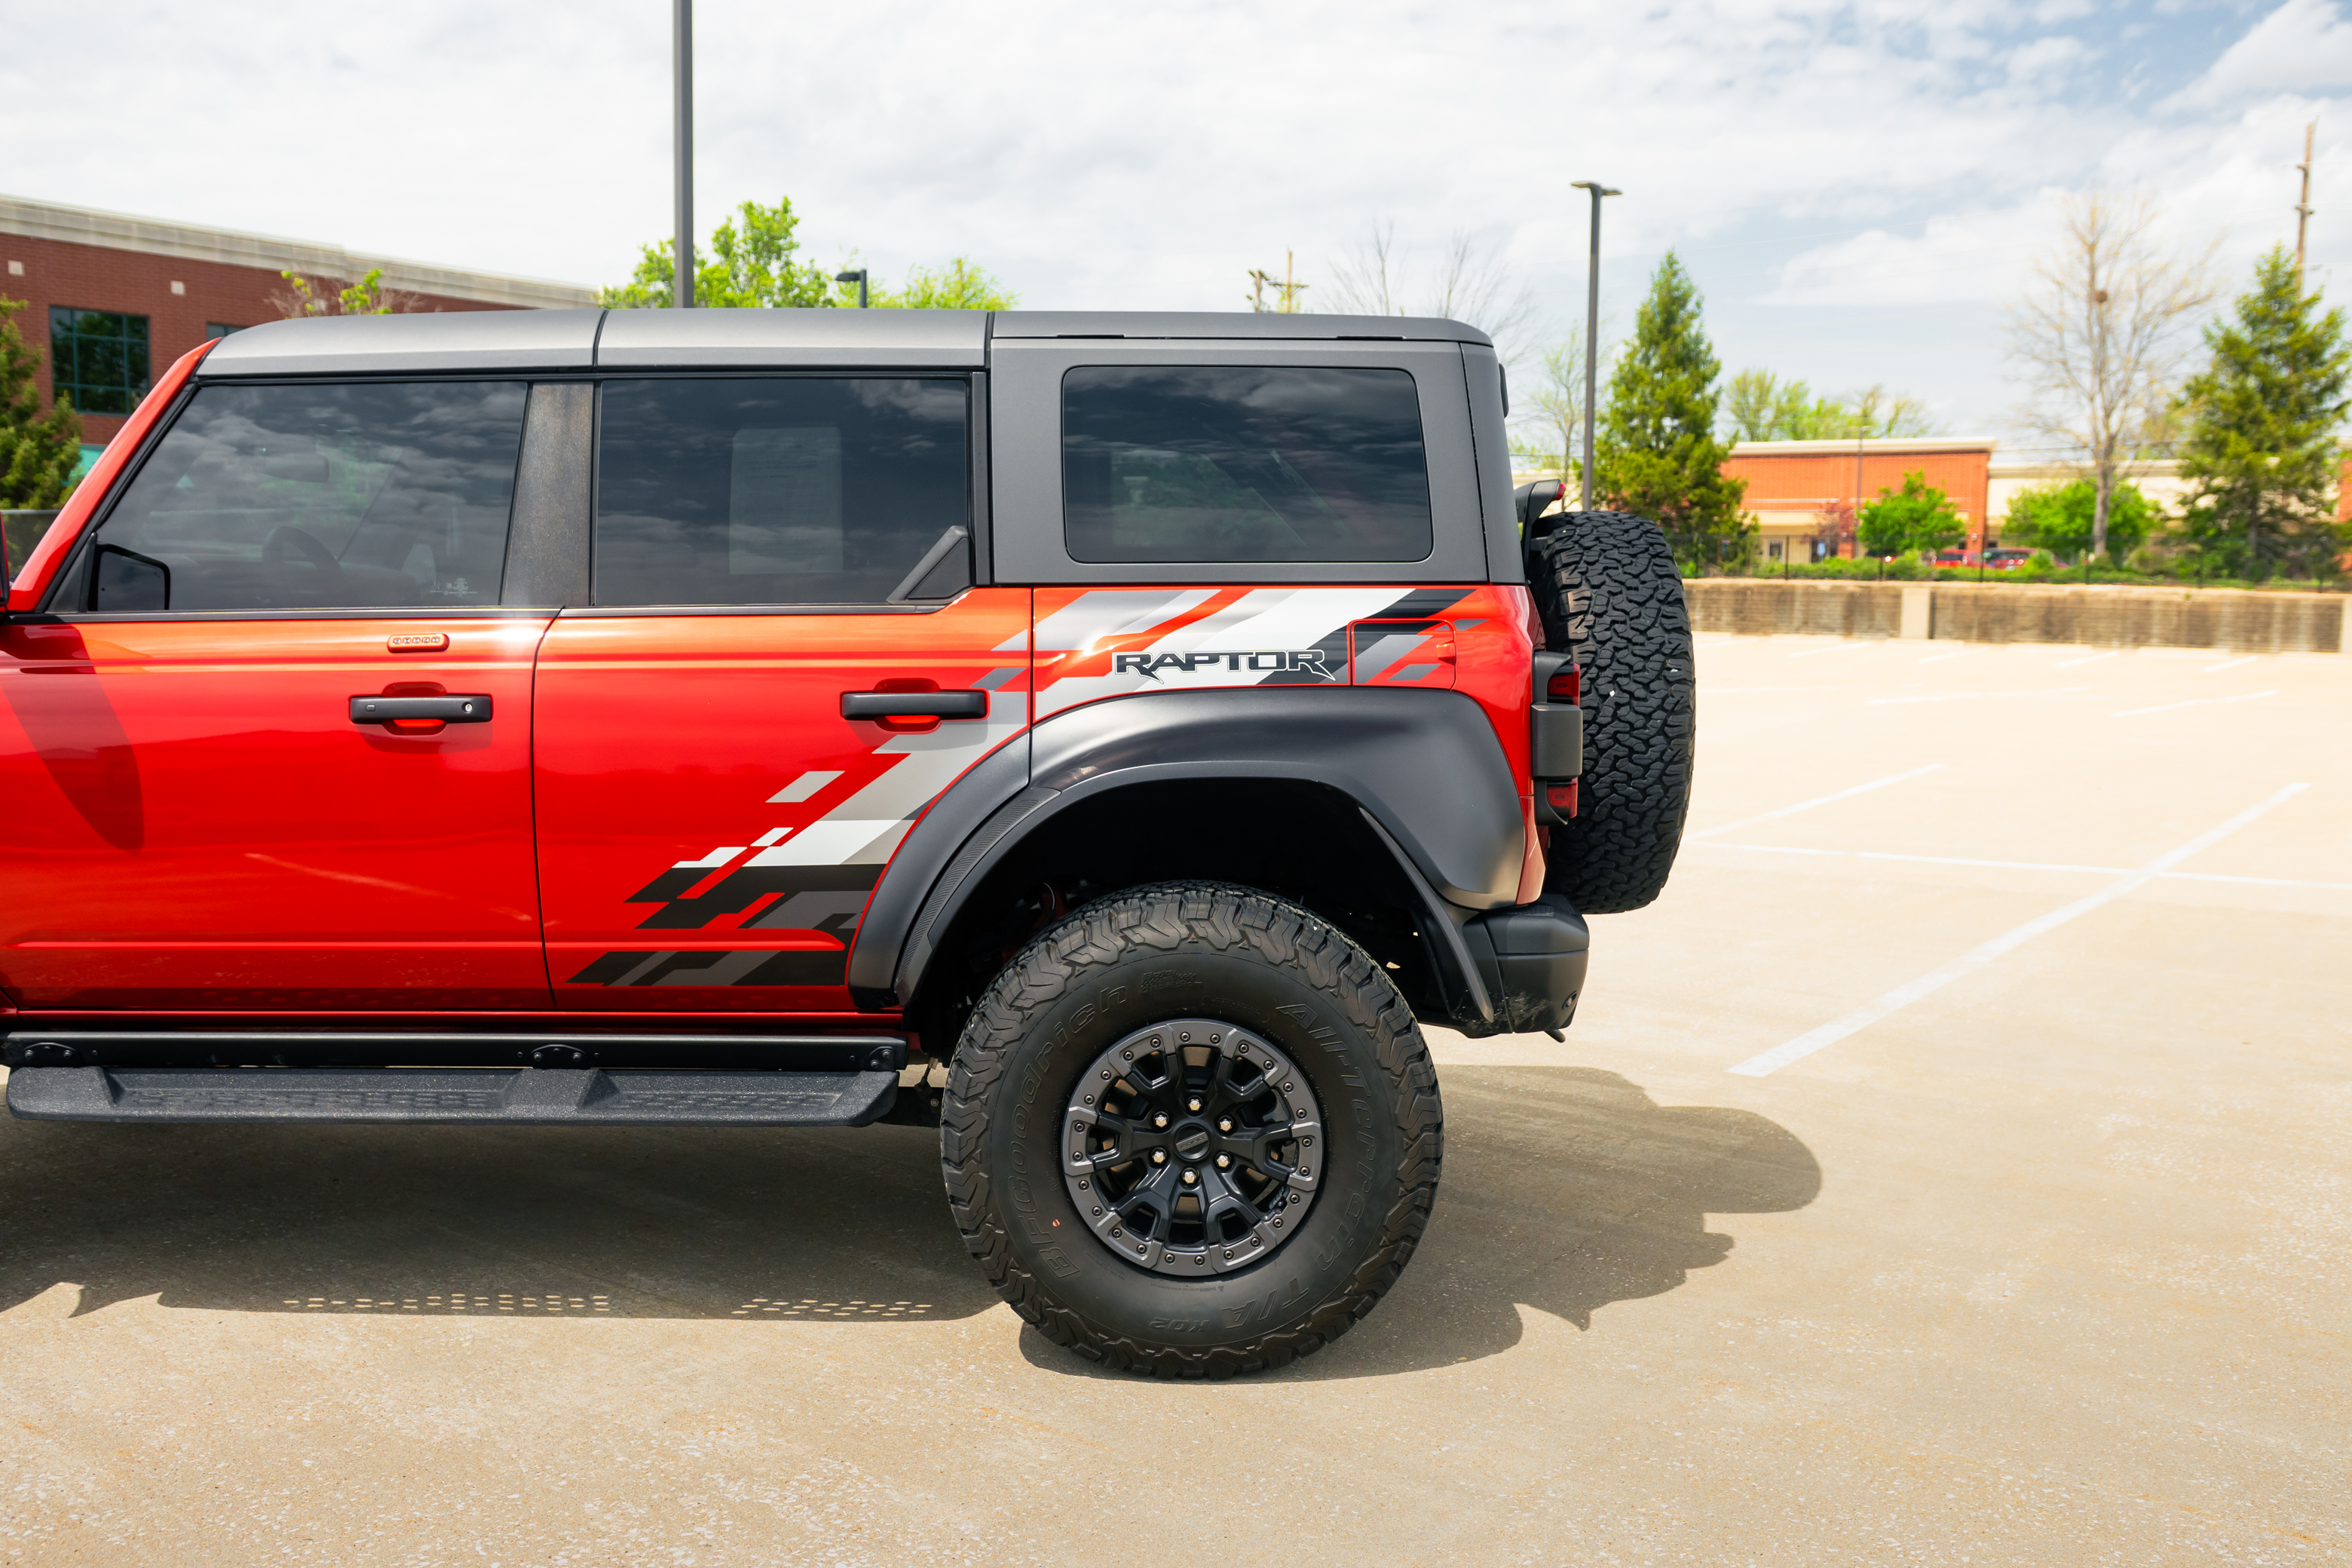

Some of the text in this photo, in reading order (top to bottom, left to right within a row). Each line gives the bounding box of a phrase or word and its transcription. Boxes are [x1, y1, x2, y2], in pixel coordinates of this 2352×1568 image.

[1114, 649, 1337, 684] RAPTOR
[1008, 982, 1127, 1279] BFGoodrich
[1179, 1135, 1205, 1150] FORD
[1276, 1003, 1373, 1272] All-Terrain
